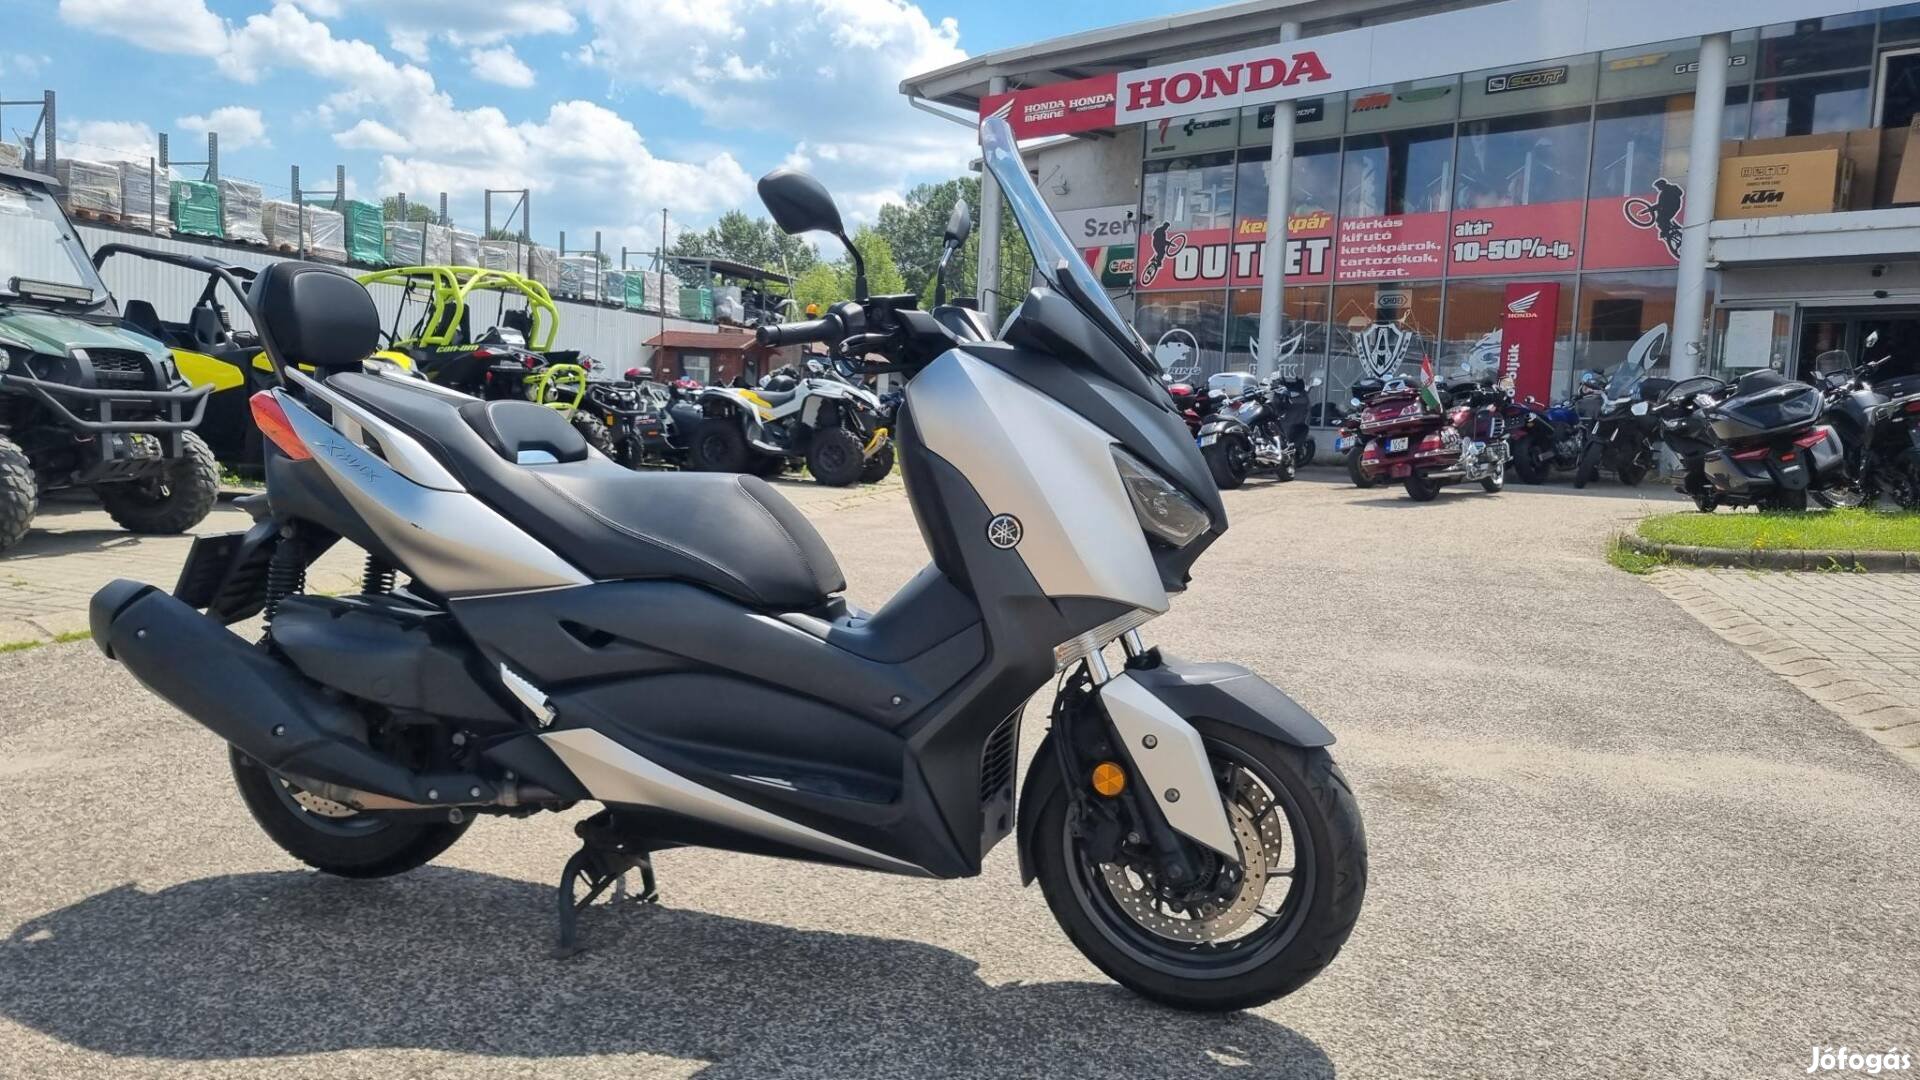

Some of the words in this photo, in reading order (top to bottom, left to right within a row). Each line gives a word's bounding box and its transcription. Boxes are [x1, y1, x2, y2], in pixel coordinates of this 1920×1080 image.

[1125, 50, 1332, 112] HONDA
[1507, 67, 1566, 90] SCOTT
[1024, 100, 1066, 113] HONDA
[1068, 93, 1115, 109] HONDA
[1741, 189, 1785, 204] KTM
[1239, 214, 1331, 234] kerkpár
[1342, 217, 1404, 230] Márkás
[1454, 220, 1493, 238] akár
[1341, 231, 1393, 243] kifutó
[1453, 237, 1575, 263] 10-50%-ig.
[1339, 267, 1410, 279] ruházat.
